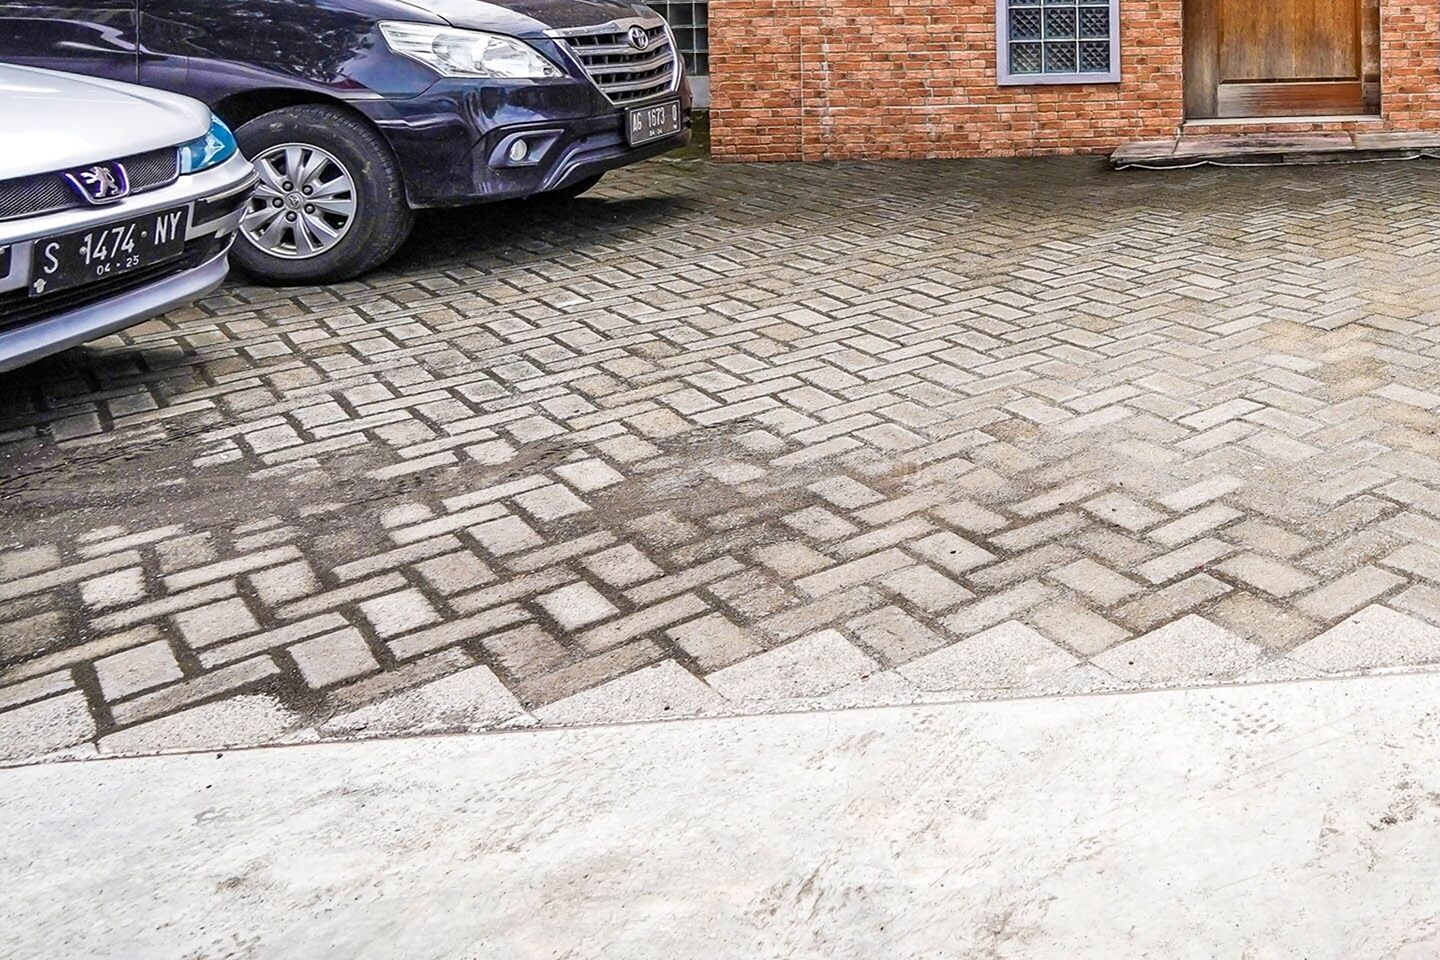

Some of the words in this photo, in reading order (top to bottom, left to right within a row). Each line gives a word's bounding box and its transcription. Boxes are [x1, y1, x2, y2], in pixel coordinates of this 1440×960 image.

[632, 112, 642, 132] AG
[647, 106, 665, 128] 1673
[43, 242, 60, 274] S
[83, 223, 137, 265] 1474
[154, 211, 182, 245] NY
